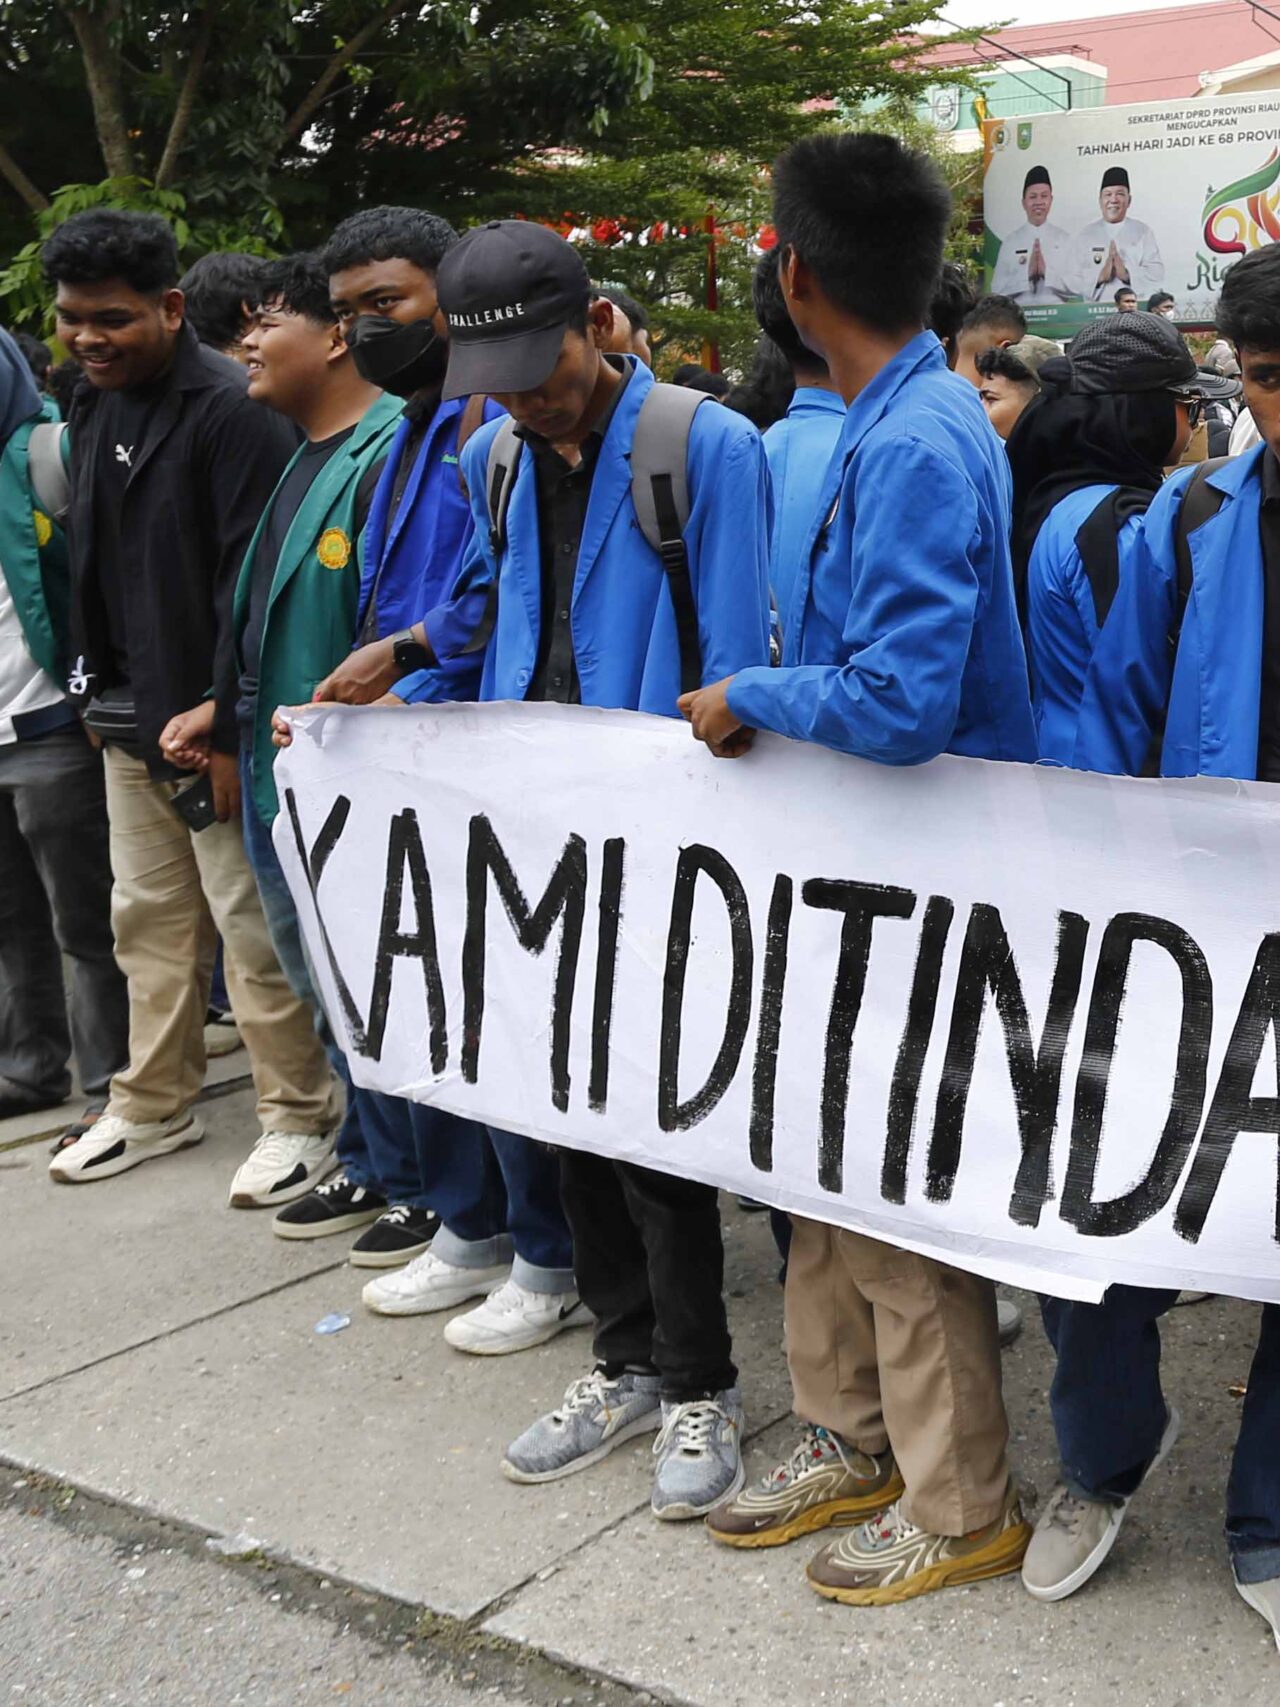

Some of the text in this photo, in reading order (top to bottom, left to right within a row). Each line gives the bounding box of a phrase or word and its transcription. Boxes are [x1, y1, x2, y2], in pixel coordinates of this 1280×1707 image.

[1127, 102, 1280, 125] SEKRETARIAT DPRD PROVINSI RIAU
[1166, 117, 1238, 132] MENGUCAPKAN
[1077, 141, 1130, 157] TAHNIAH
[1133, 138, 1164, 152] HARI
[1166, 136, 1195, 149] JADI
[1198, 134, 1215, 146] KE
[1218, 132, 1234, 144] 68
[448, 302, 525, 327] CHALLENGE
[284, 786, 626, 1116] KAMI
